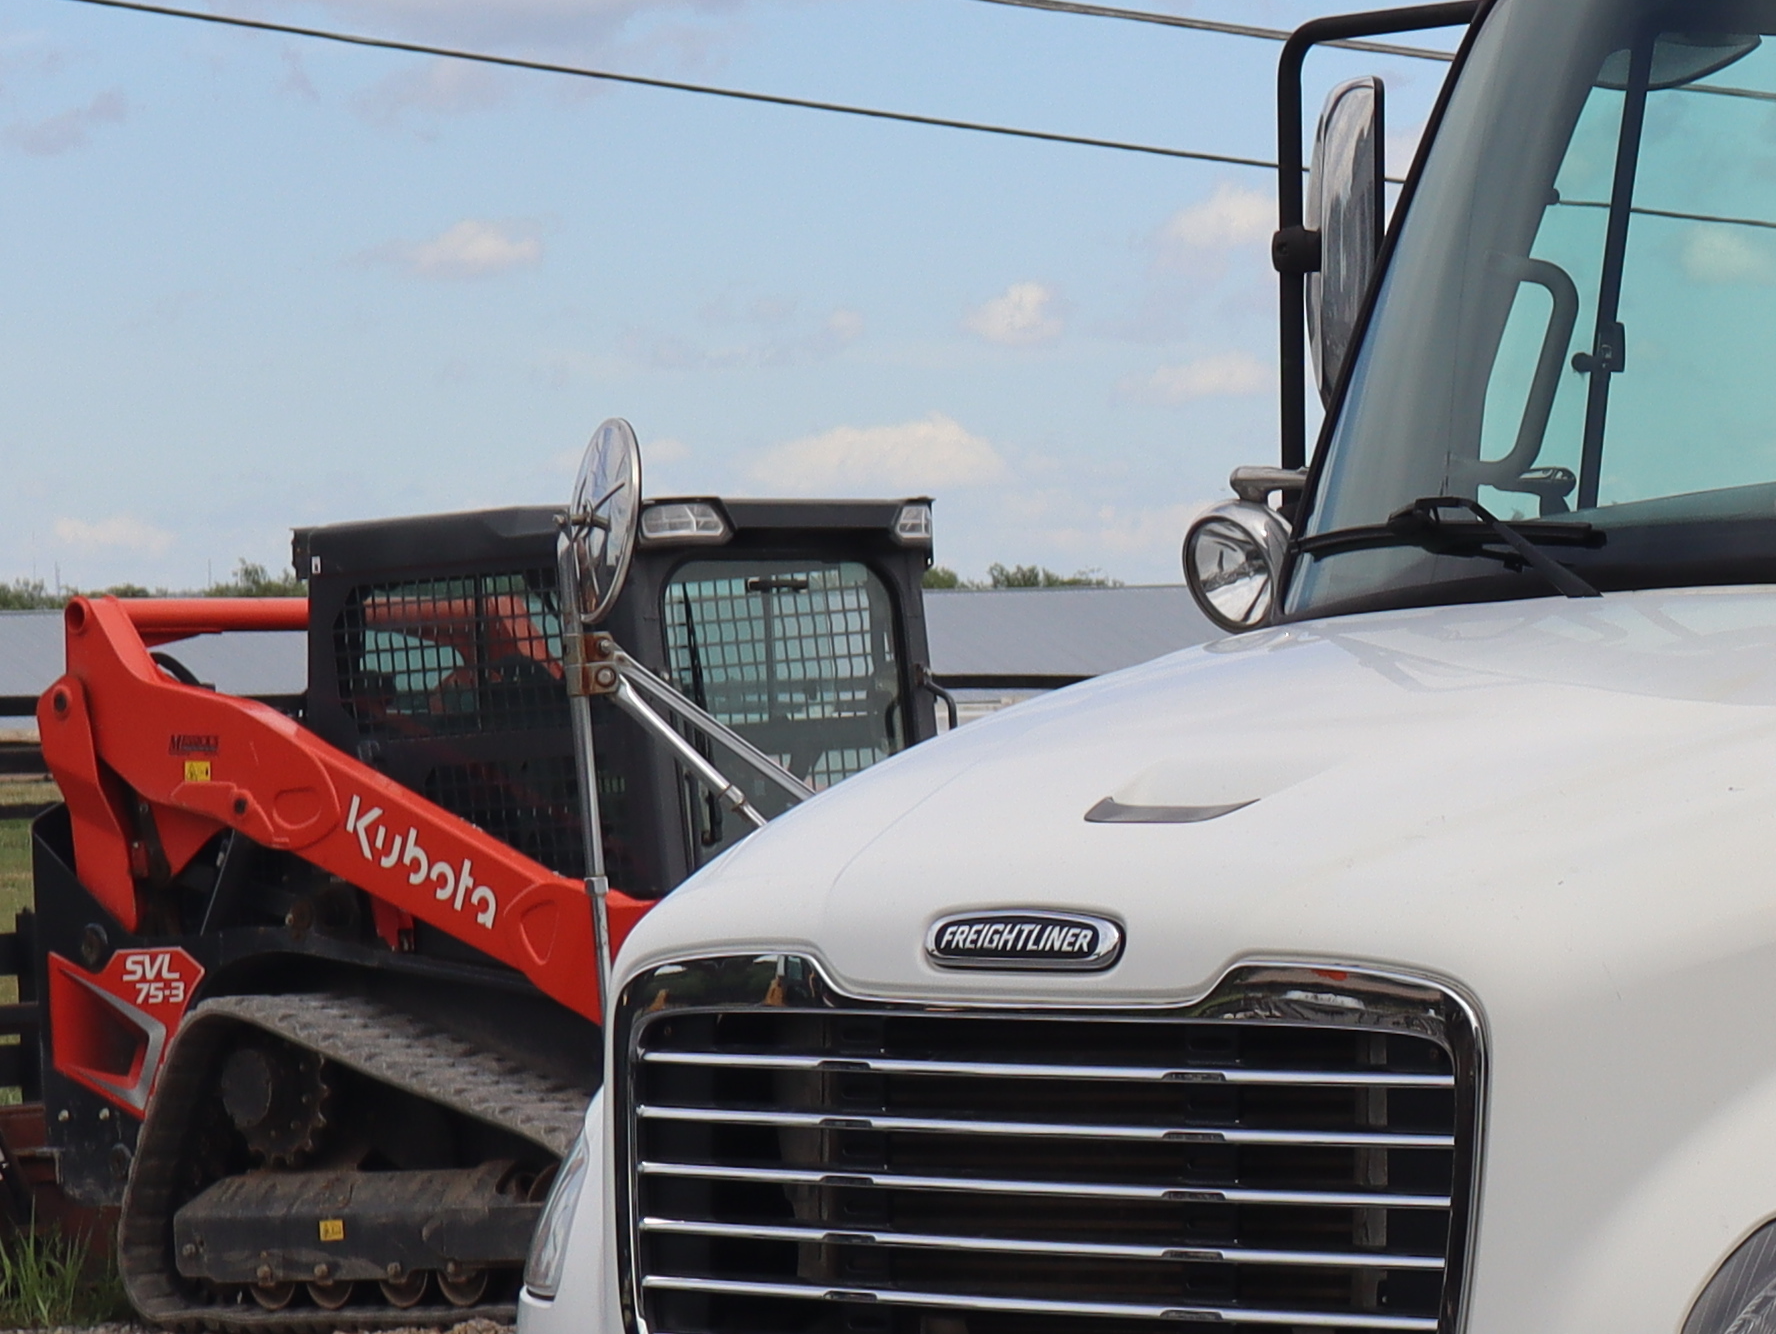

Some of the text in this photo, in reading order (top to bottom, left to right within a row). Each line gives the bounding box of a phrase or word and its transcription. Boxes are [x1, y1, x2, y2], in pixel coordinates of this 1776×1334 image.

[346, 794, 497, 929] Kubota
[940, 923, 1093, 952] FREIGHTLINER
[123, 953, 180, 982] SVL
[135, 981, 185, 1005] 75-3
